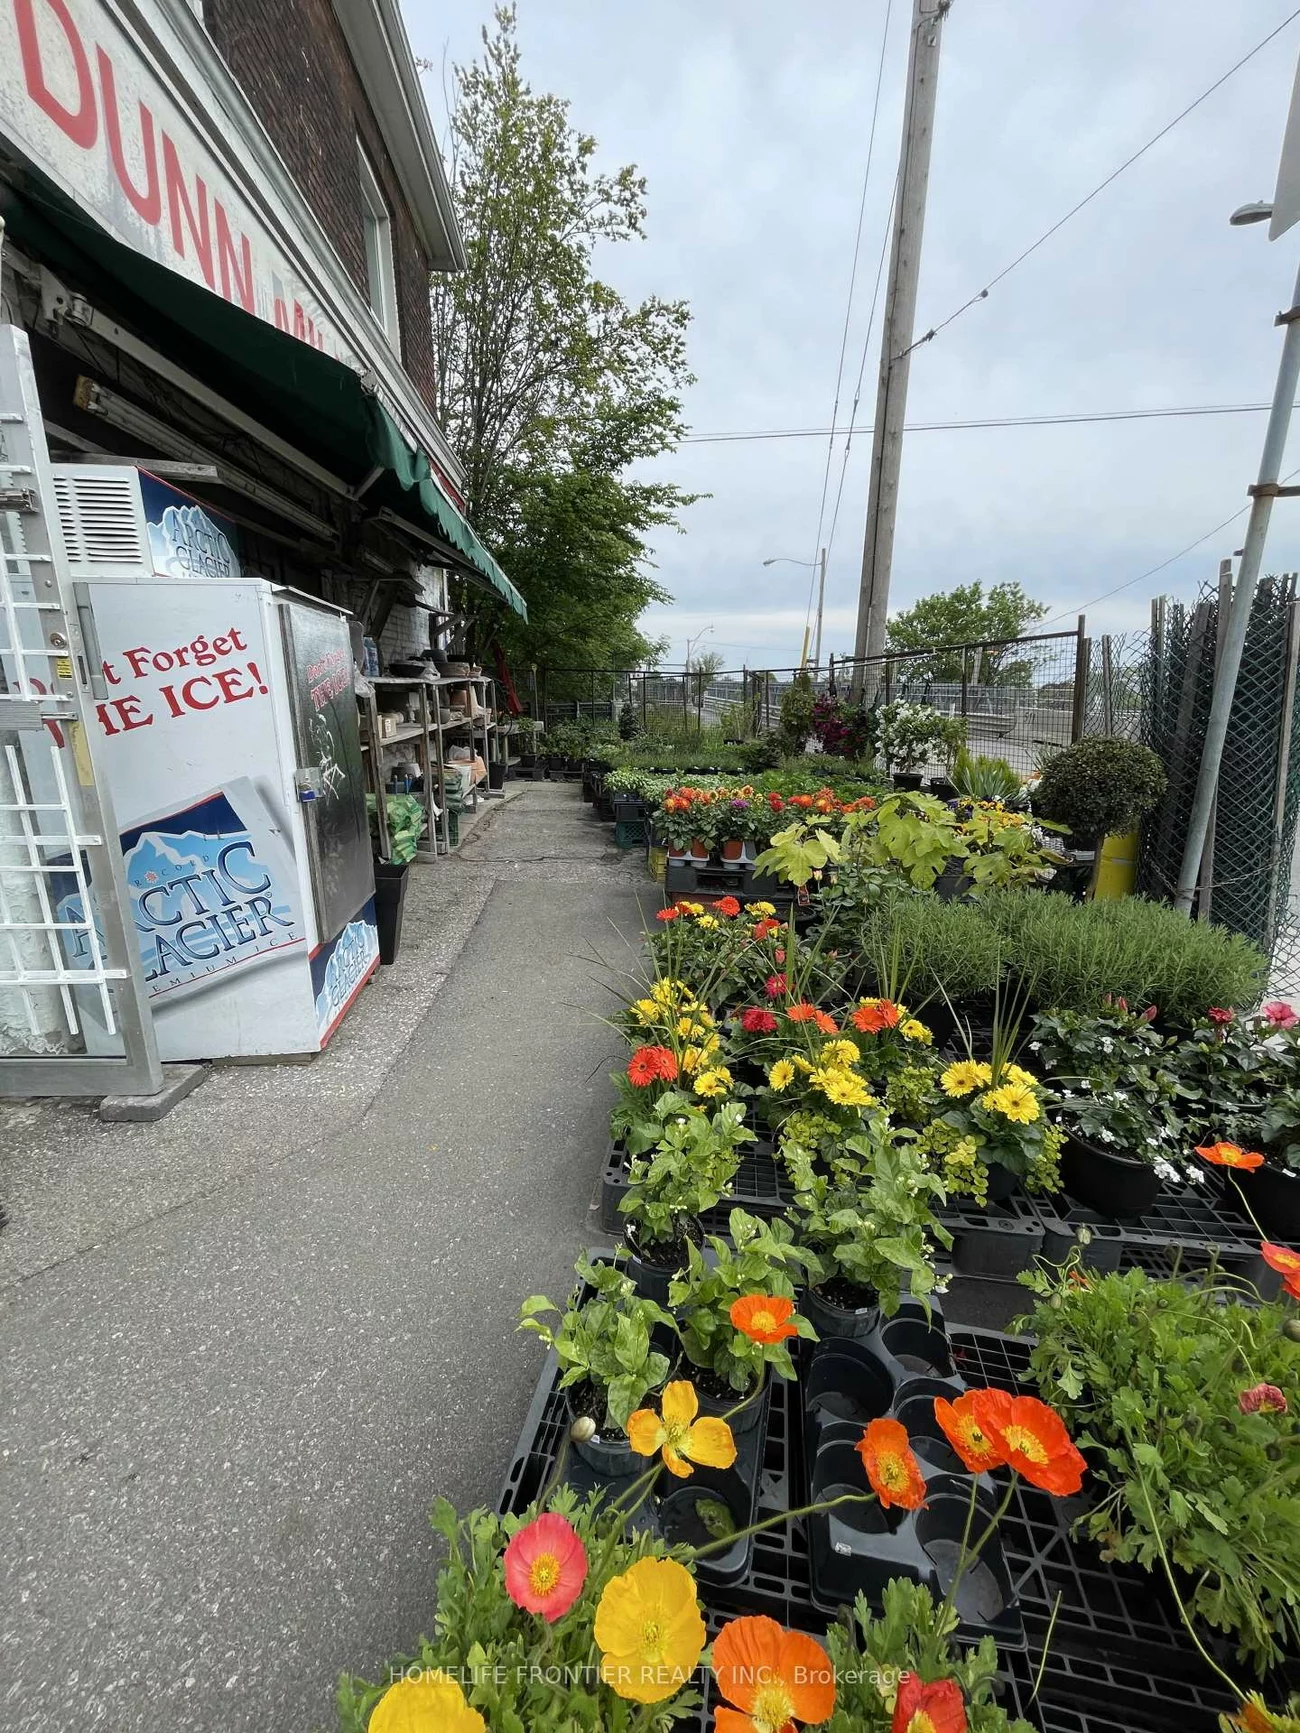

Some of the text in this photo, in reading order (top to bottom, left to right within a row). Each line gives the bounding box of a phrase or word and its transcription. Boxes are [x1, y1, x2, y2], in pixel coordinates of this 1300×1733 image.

[13, 0, 256, 316] DUNN
[172, 510, 230, 564] ARCTIC
[123, 627, 247, 679] Forget
[159, 662, 269, 718] ICE!
[255, 931, 298, 952] ICE
